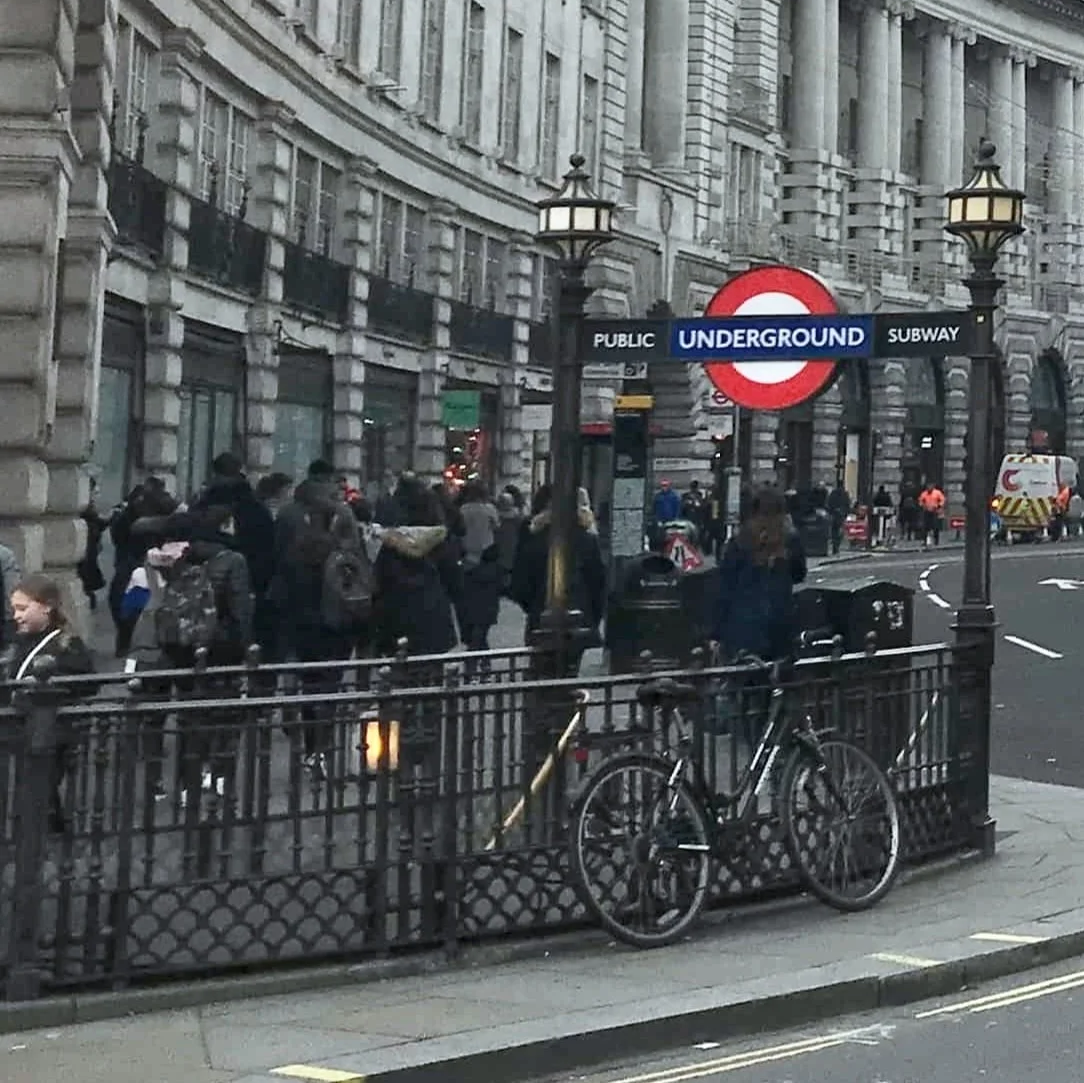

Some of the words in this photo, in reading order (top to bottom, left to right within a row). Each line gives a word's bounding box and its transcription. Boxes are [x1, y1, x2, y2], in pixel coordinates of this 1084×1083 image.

[593, 332, 656, 349] PUBLIC
[678, 327, 866, 349] UNDERGROUND
[887, 326, 960, 344] SUBWAY
